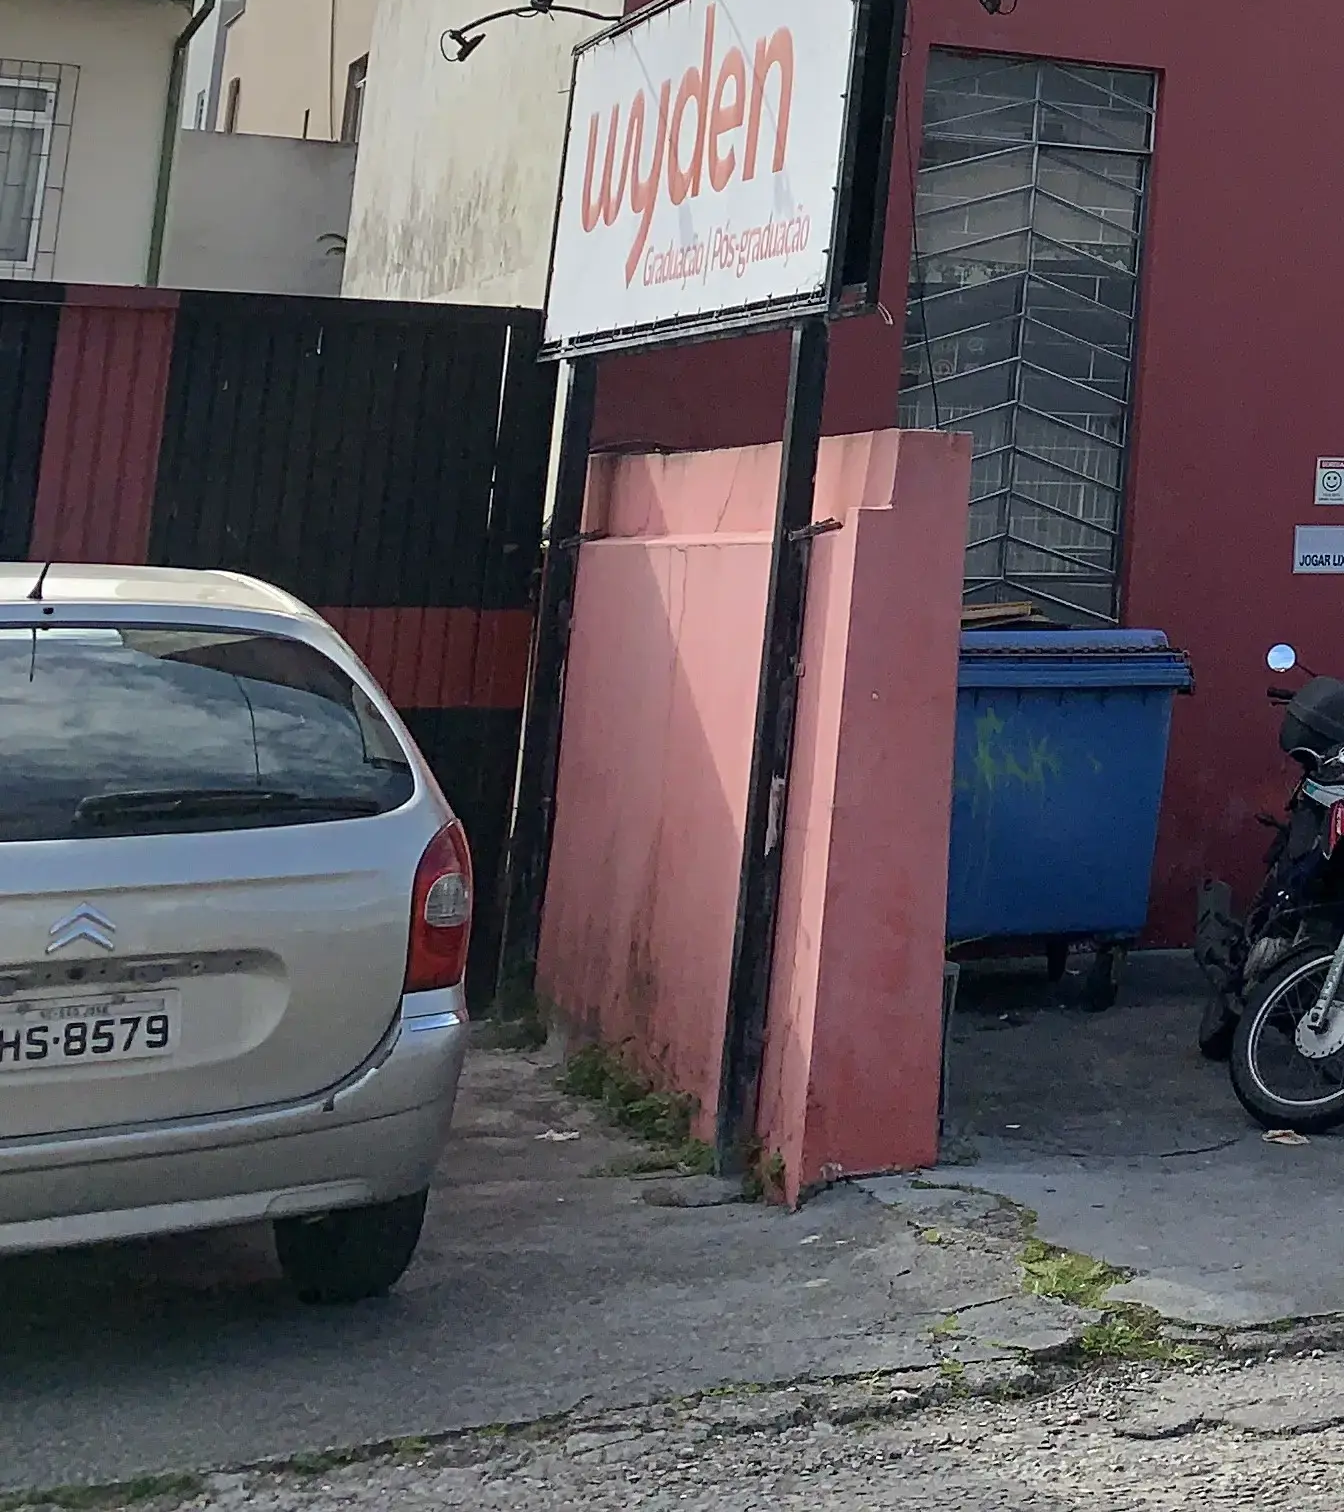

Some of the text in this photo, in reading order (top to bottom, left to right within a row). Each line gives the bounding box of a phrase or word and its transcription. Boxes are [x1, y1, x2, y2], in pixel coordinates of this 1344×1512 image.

[581, 1, 794, 290] wyden
[643, 235, 703, 290] Graduação
[711, 204, 811, 279] Pós-graduação
[1299, 554, 1331, 567] JOGAR
